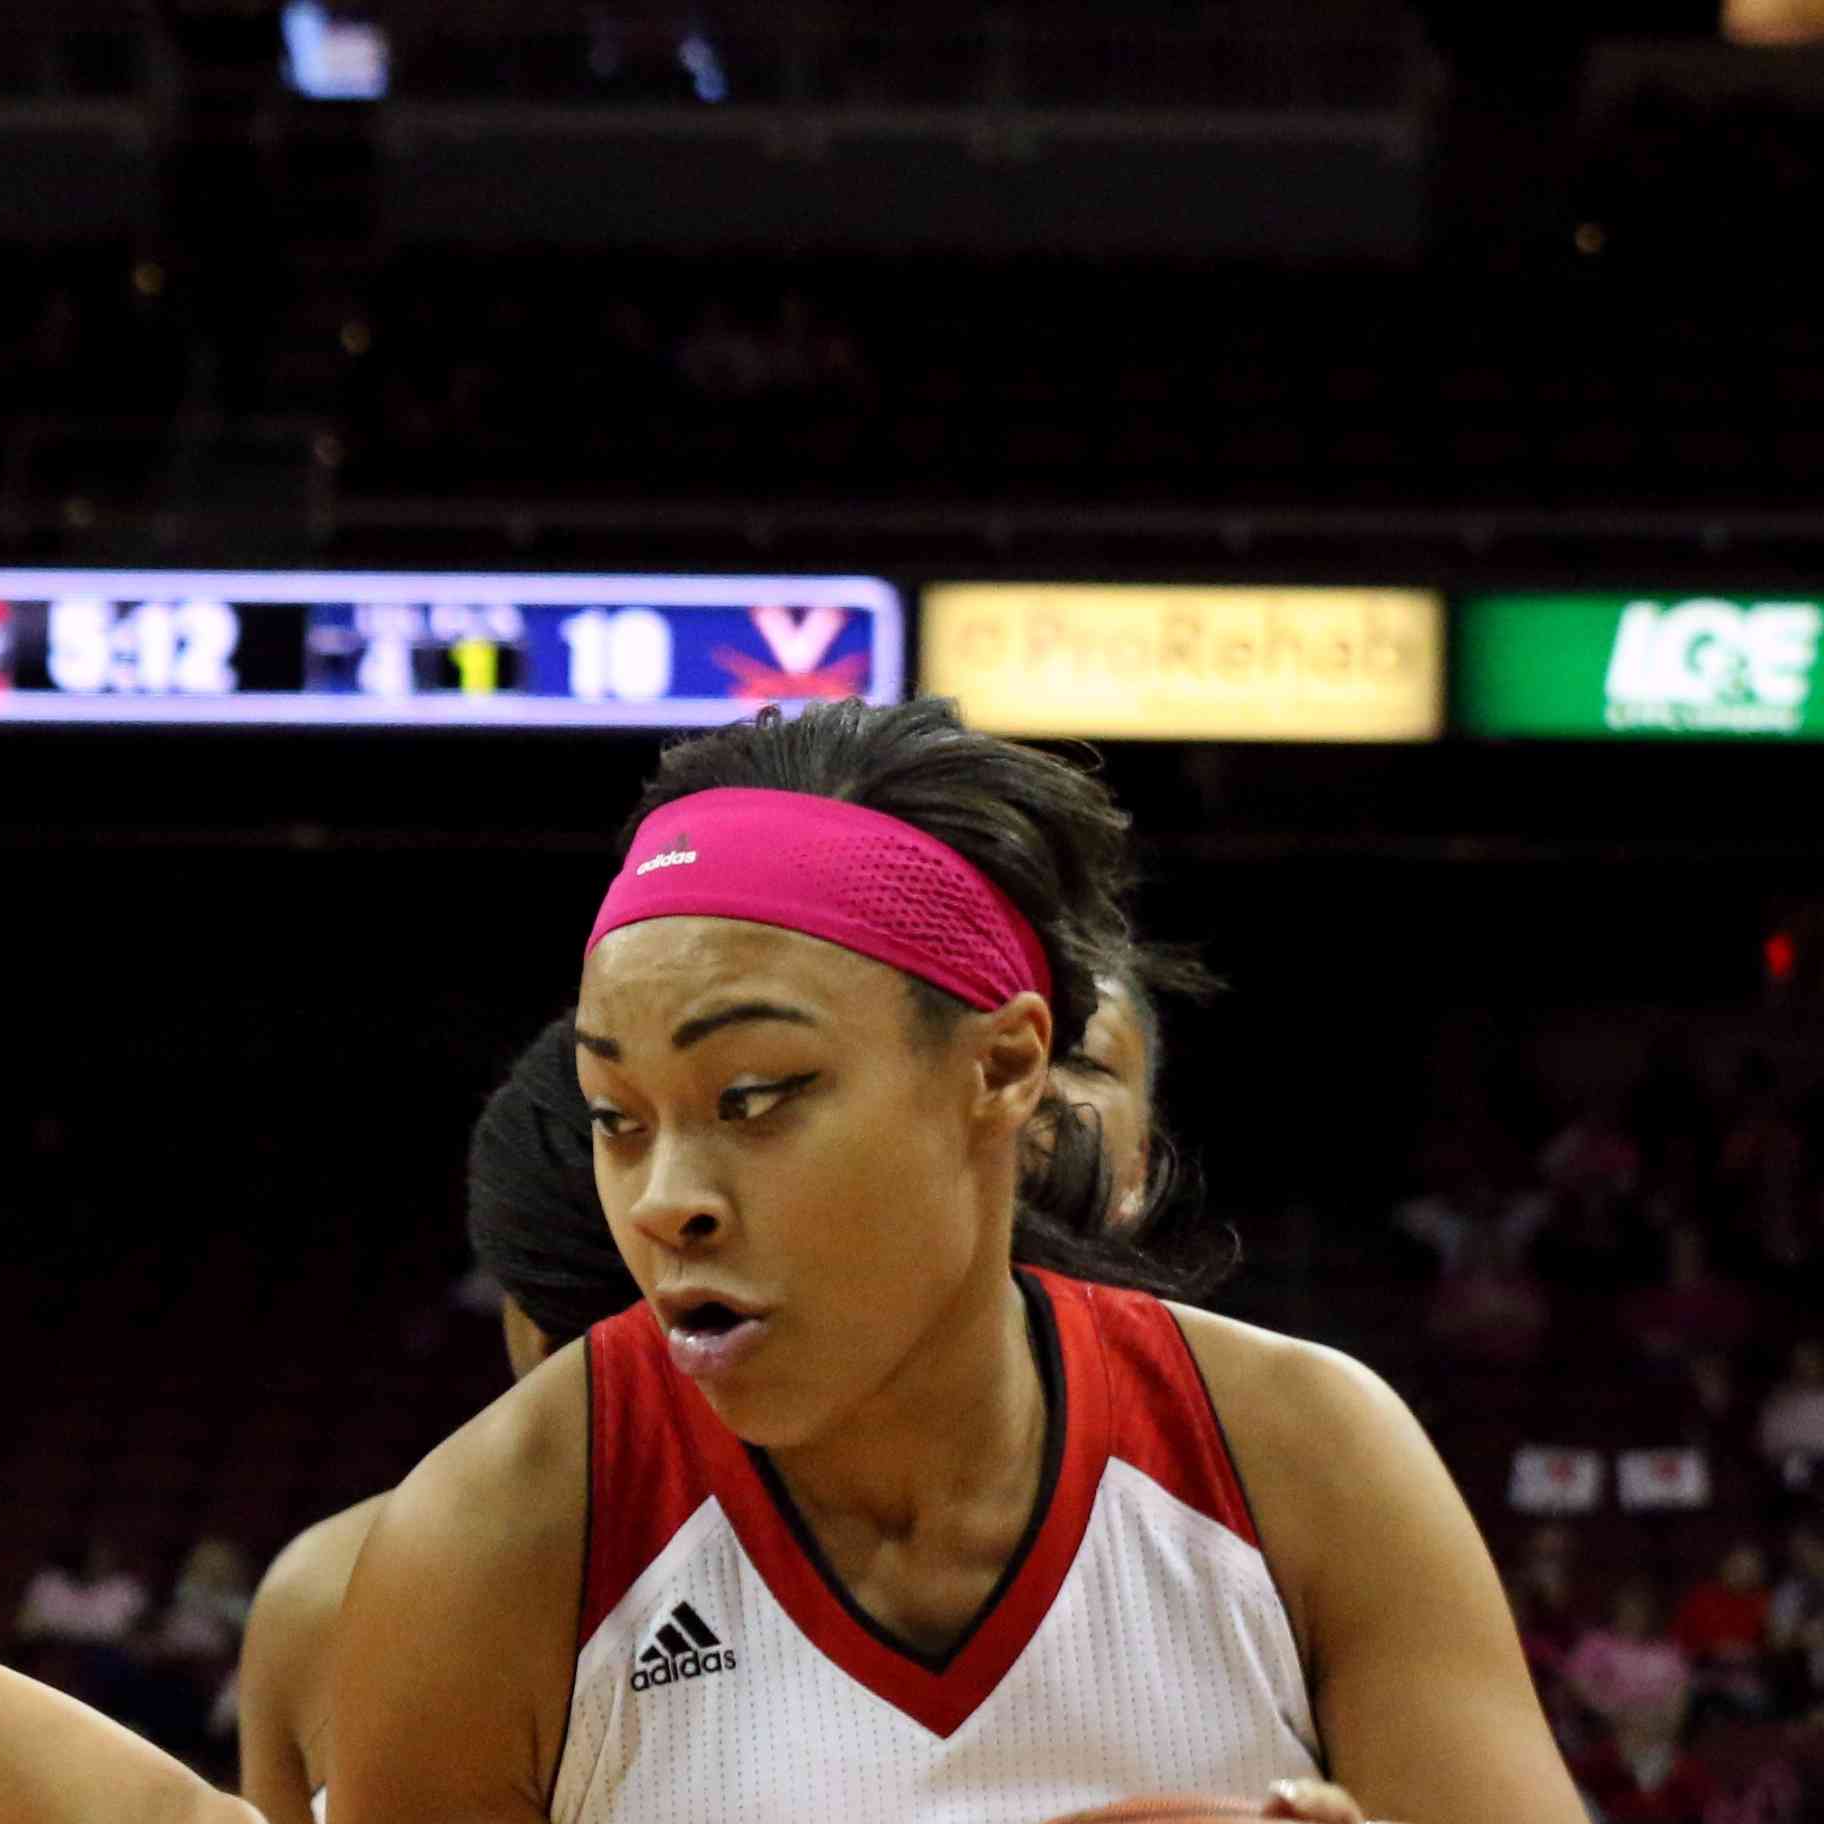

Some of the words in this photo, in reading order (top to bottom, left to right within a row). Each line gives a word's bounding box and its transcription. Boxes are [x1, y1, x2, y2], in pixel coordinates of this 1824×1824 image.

[560, 608, 670, 700] 10
[636, 850, 697, 876] adidas
[630, 1649, 737, 1692] adidas
